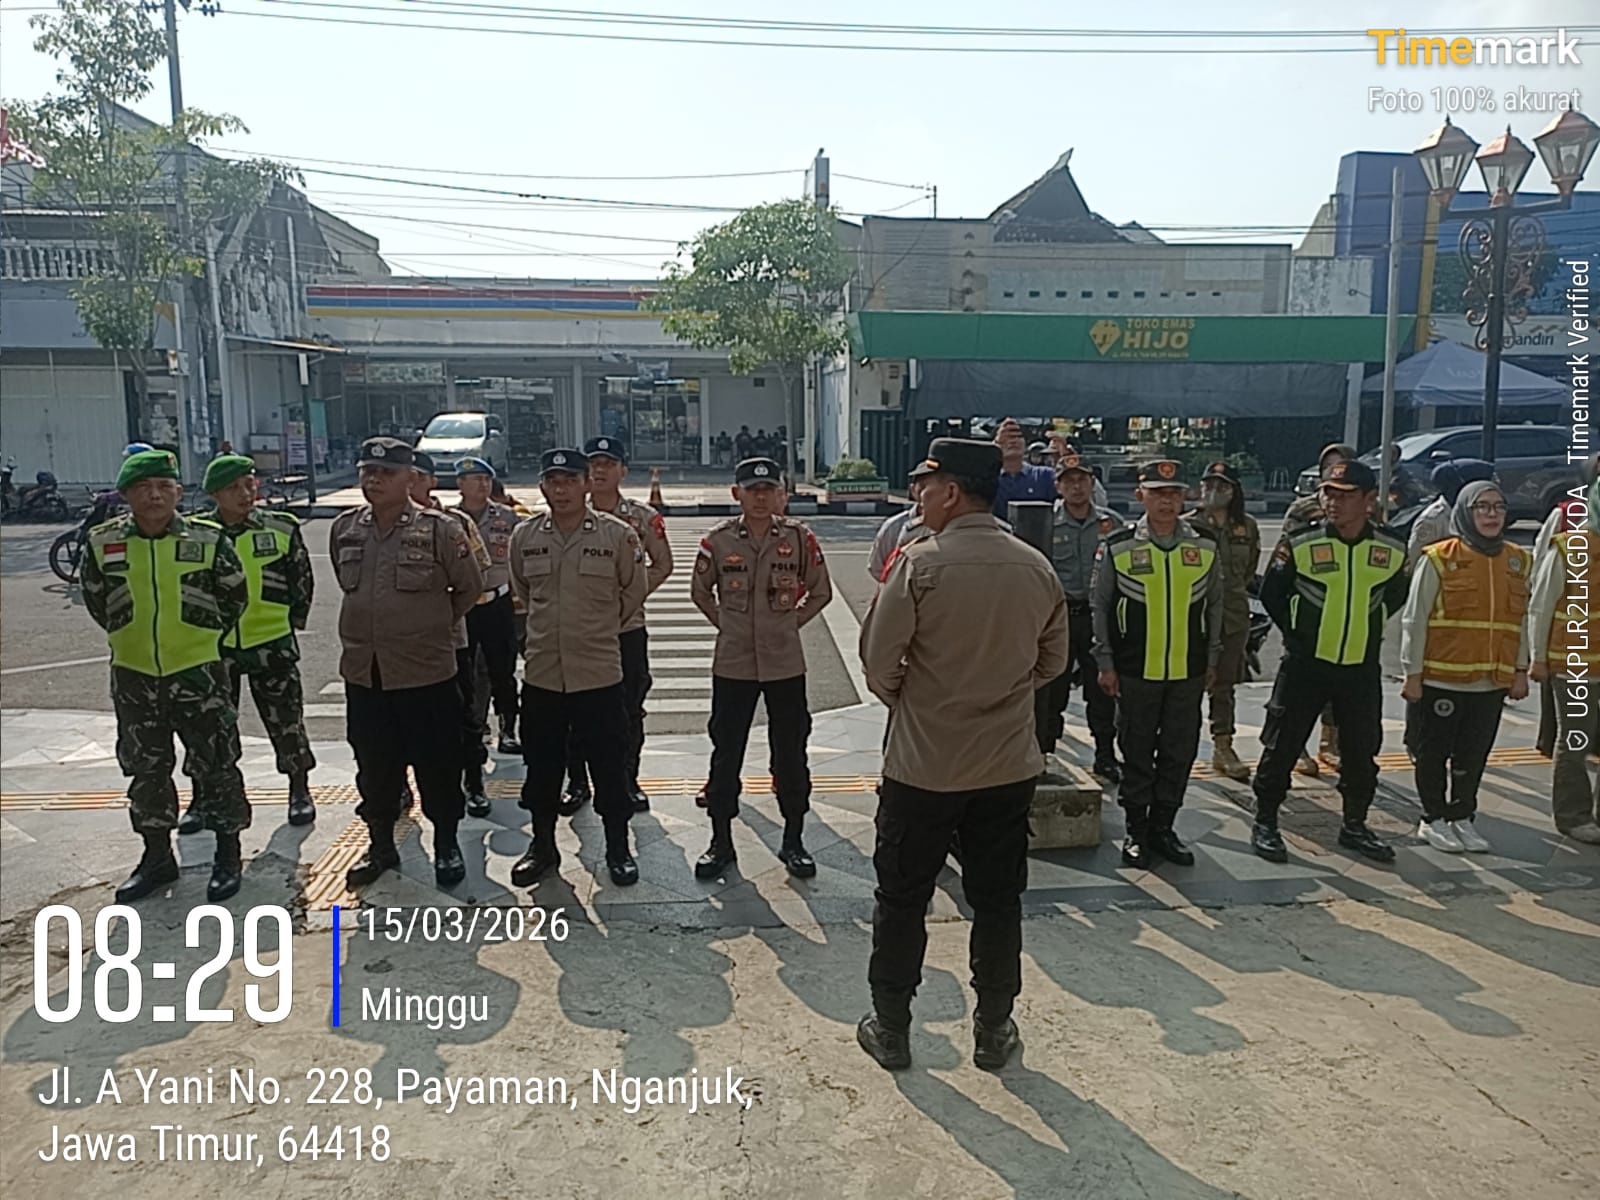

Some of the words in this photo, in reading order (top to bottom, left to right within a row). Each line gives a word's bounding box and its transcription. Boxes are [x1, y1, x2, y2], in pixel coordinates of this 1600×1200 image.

[1126, 318, 1160, 329] TOKO
[1162, 318, 1196, 330] EMAS
[1122, 331, 1189, 349] HIJO
[583, 548, 614, 558] POLRI
[771, 562, 798, 572] POLRI
